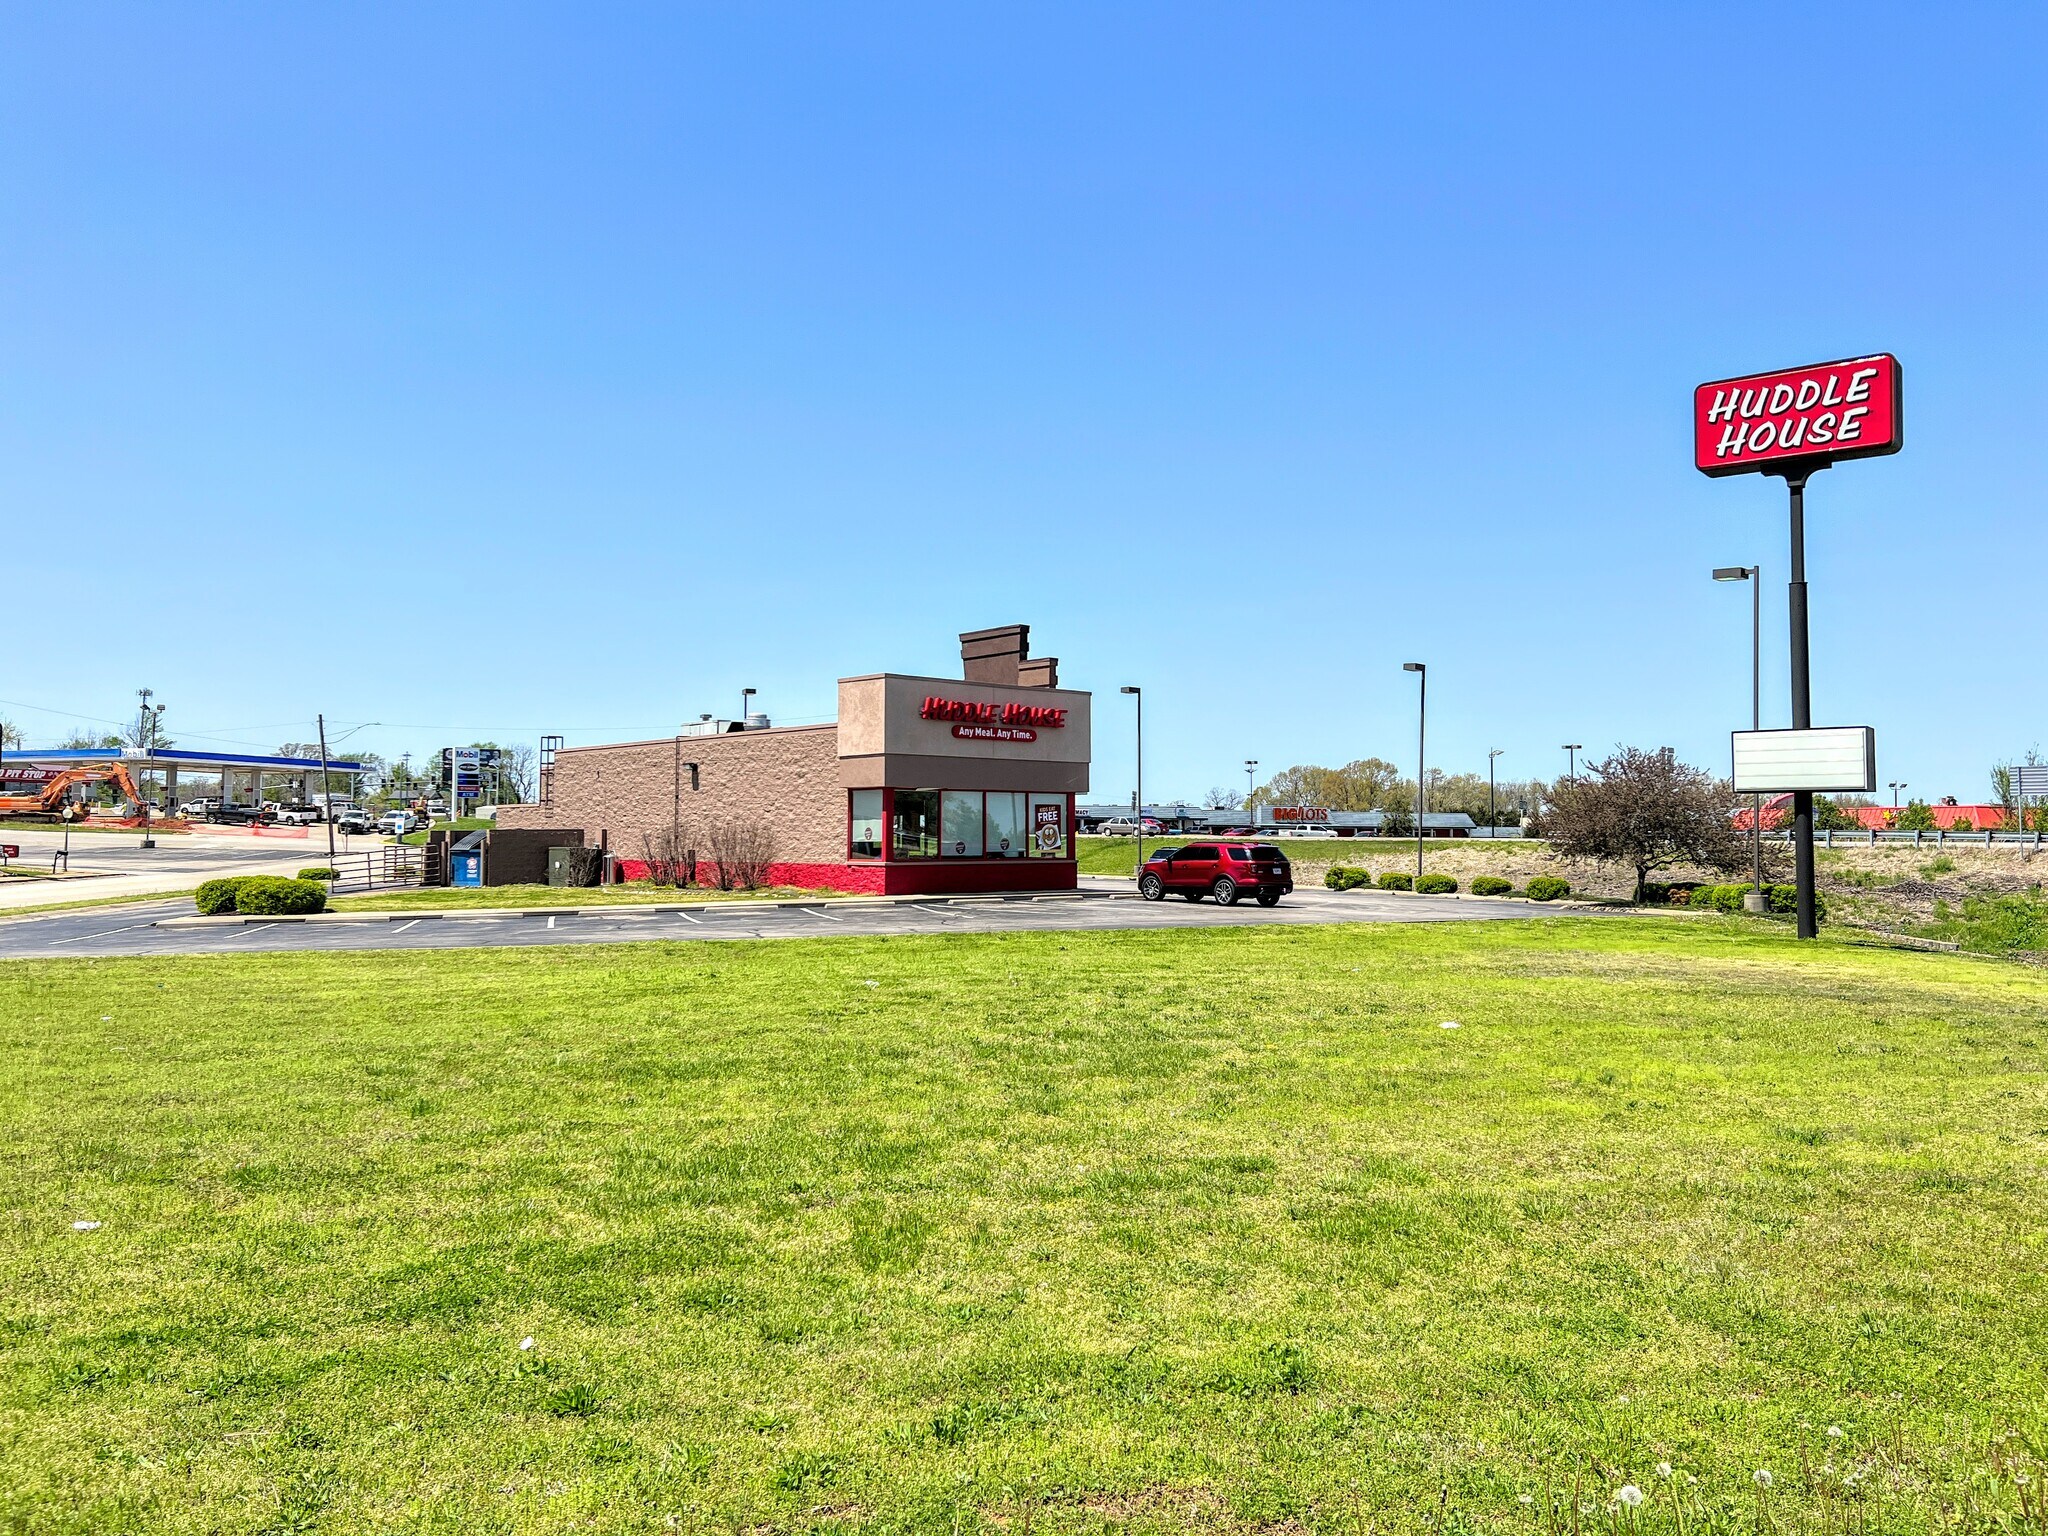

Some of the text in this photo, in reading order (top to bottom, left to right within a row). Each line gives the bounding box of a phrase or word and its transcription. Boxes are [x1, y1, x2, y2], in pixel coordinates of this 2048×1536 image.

[1708, 368, 1877, 423] HUDDLE
[1716, 406, 1868, 456] HOUSE
[920, 696, 1068, 728] HUDDLE HOUSE
[959, 726, 1033, 740] Any Meal. Any Time.
[456, 750, 478, 758] Mobil
[5, 769, 22, 778] PIT
[22, 769, 47, 779] STOP
[1038, 811, 1058, 822] FREE
